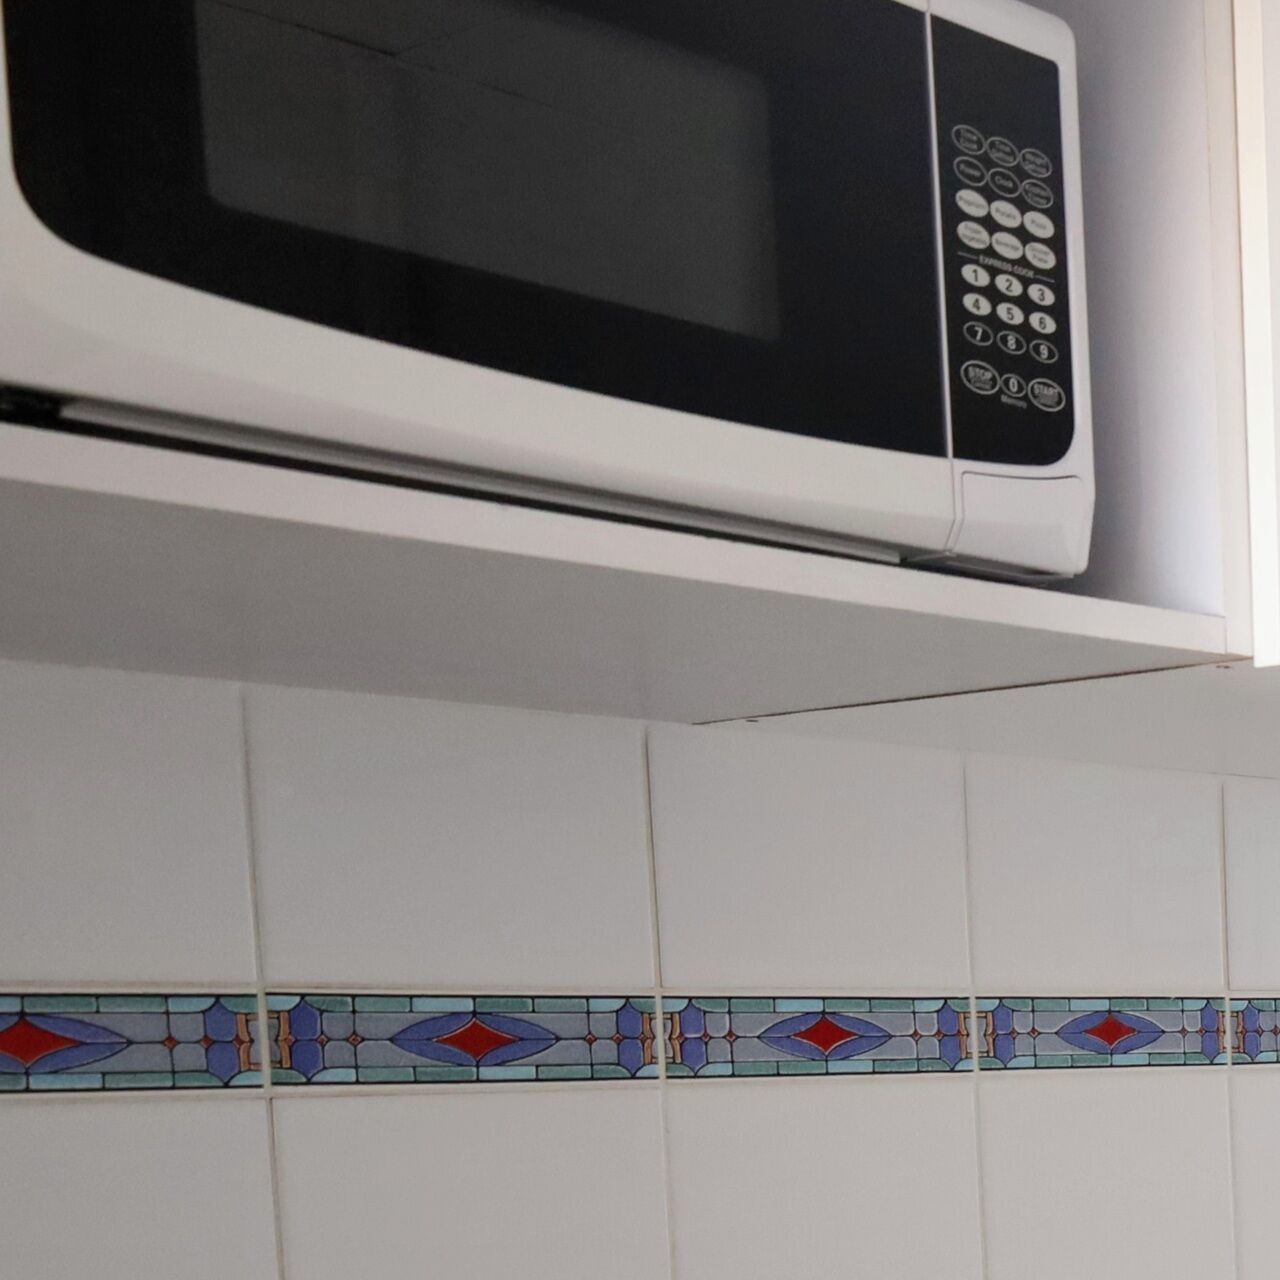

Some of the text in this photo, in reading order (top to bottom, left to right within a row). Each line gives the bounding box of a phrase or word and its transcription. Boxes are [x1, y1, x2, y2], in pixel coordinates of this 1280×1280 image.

[972, 269, 978, 283] 1
[1005, 278, 1013, 292] 2
[1037, 288, 1045, 302] 3
[972, 298, 981, 311] 4
[1006, 307, 1014, 321] 5
[1038, 316, 1046, 330] 6
[974, 326, 983, 340] 7
[1007, 335, 1016, 350] 8
[1039, 344, 1049, 359] 9
[968, 366, 992, 380] STOP
[1009, 379, 1018, 392] 0
[1034, 383, 1059, 396] START
